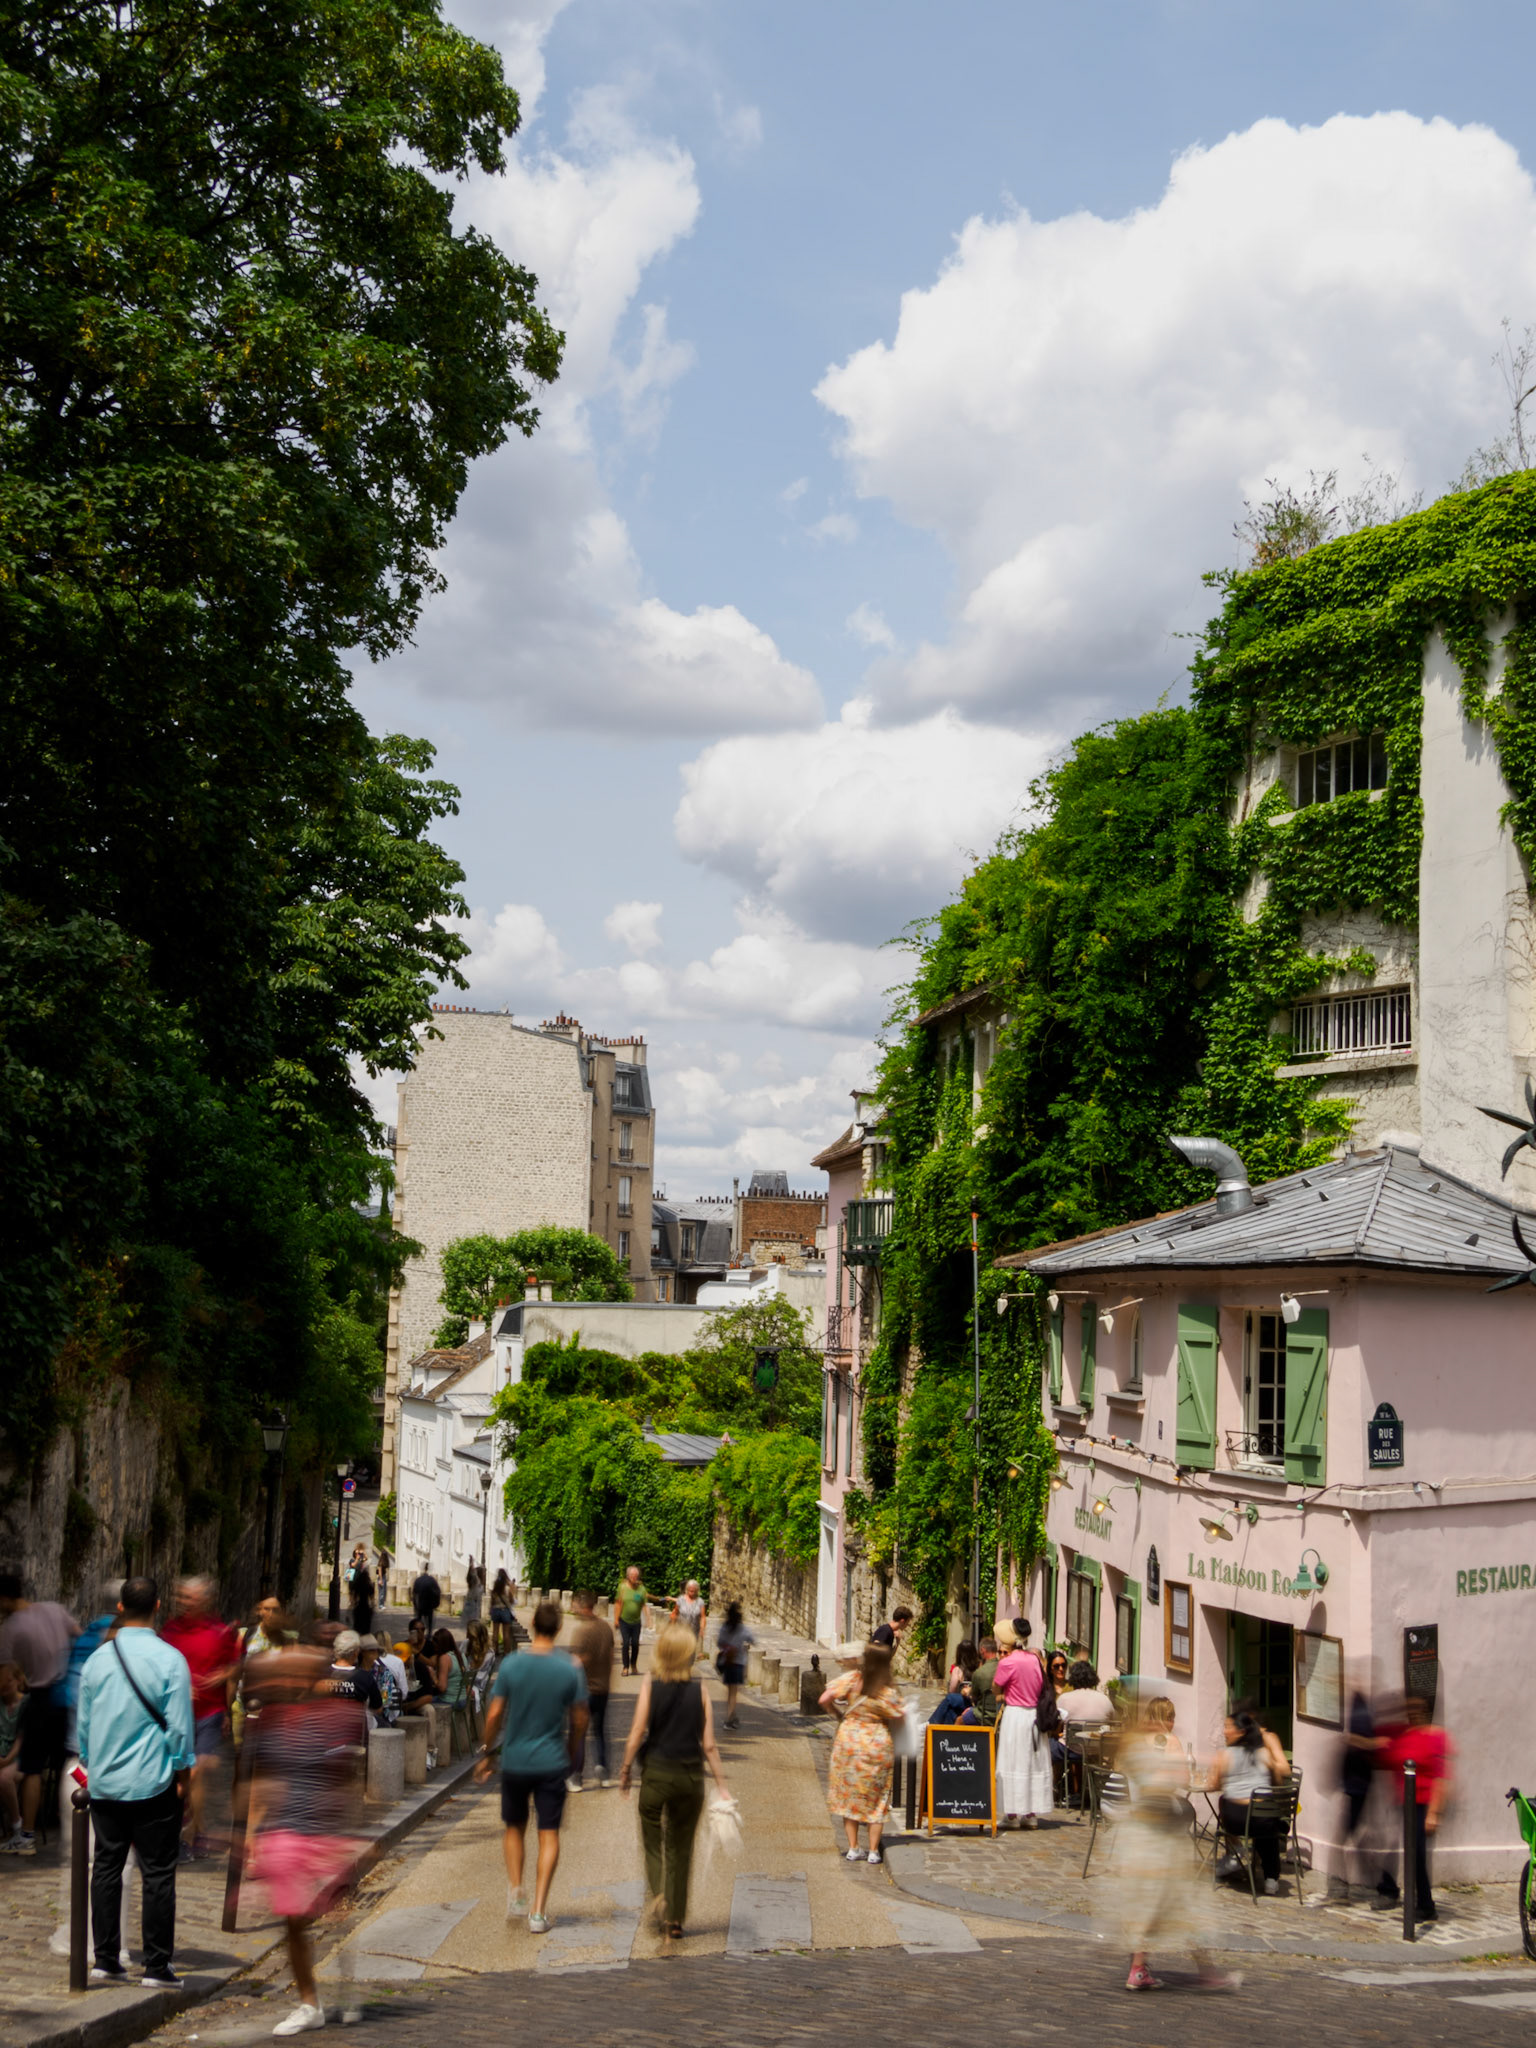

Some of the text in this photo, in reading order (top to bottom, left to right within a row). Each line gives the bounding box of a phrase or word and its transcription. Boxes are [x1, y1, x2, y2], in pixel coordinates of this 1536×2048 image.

[1378, 1428, 1394, 1440] RUE
[1373, 1449, 1401, 1461] SAULES
[1074, 1506, 1112, 1542] RESTAURANT
[1187, 1552, 1309, 1600] La Maison Ro
[1456, 1564, 1536, 1597] RESTAUR
[939, 1738, 960, 1752] Please
